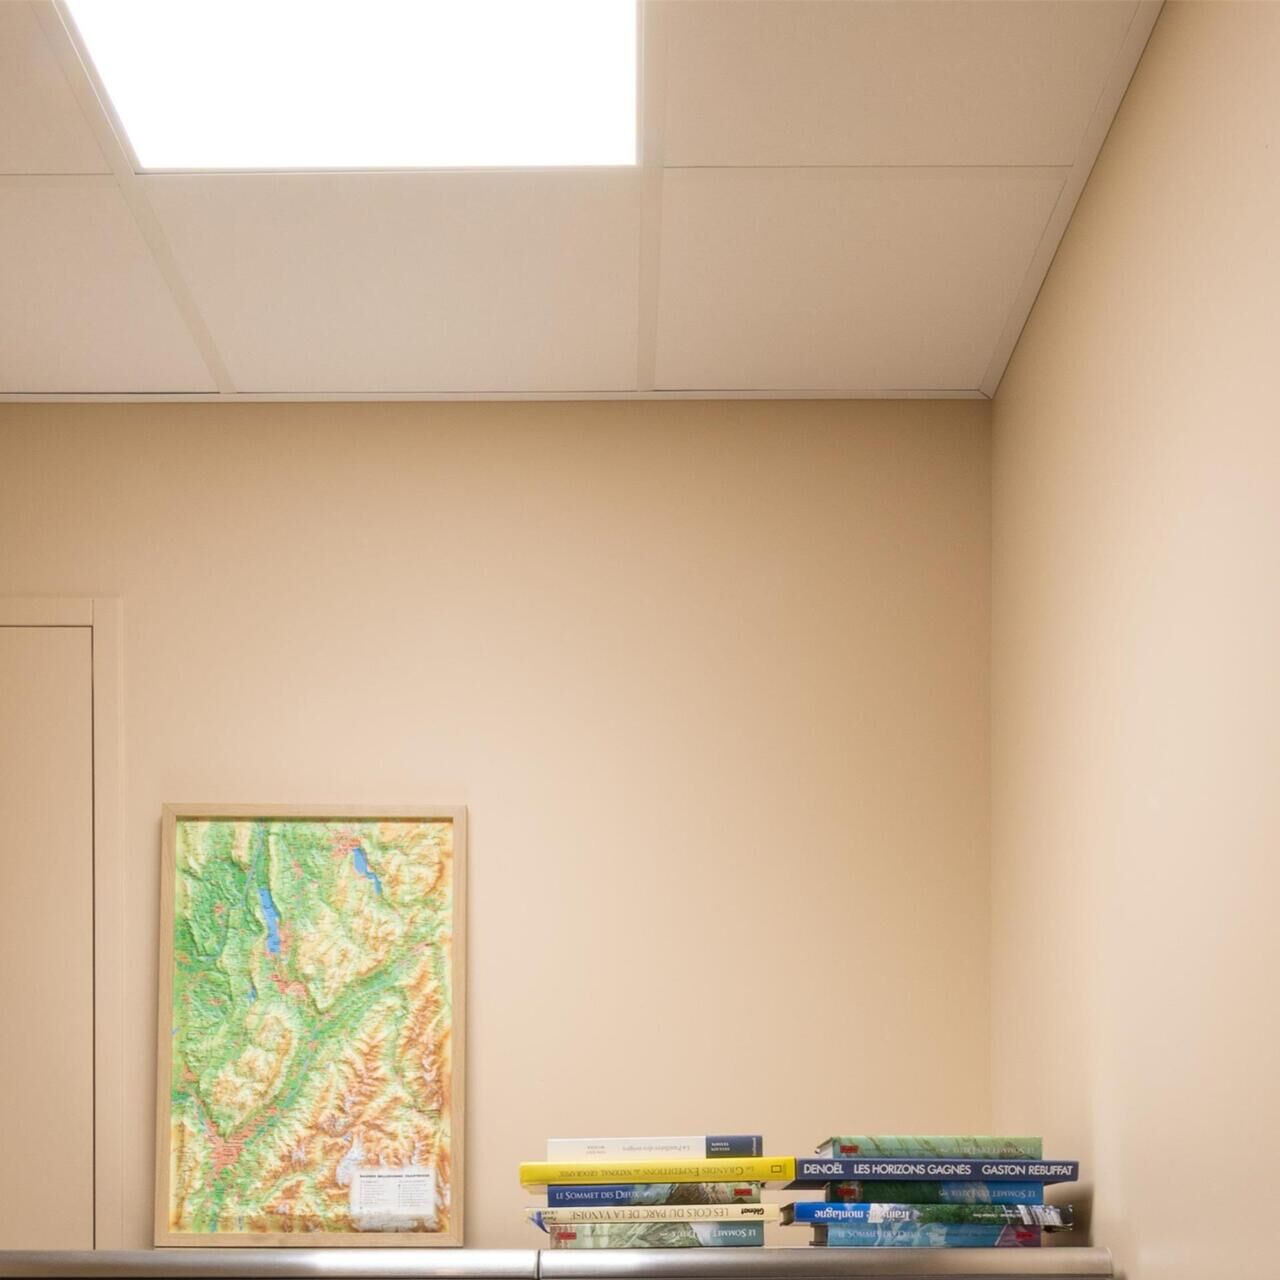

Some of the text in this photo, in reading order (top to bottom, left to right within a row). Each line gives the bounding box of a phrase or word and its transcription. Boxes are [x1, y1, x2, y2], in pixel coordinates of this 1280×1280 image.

[803, 1162, 845, 1174] DENOËL
[853, 1164, 871, 1174] LES
[872, 1164, 925, 1175] HORIZONS
[982, 1164, 1026, 1175] GASTON
[556, 1192, 564, 1200] LE
[565, 1190, 599, 1200] SOMMET
[600, 1191, 615, 1199] DES
[627, 1210, 640, 1218] DE
[643, 1209, 667, 1218] PARC
[670, 1209, 684, 1217] DU
[687, 1208, 711, 1217] COLS
[713, 1208, 729, 1217] LES
[814, 1207, 865, 1220] montagne
